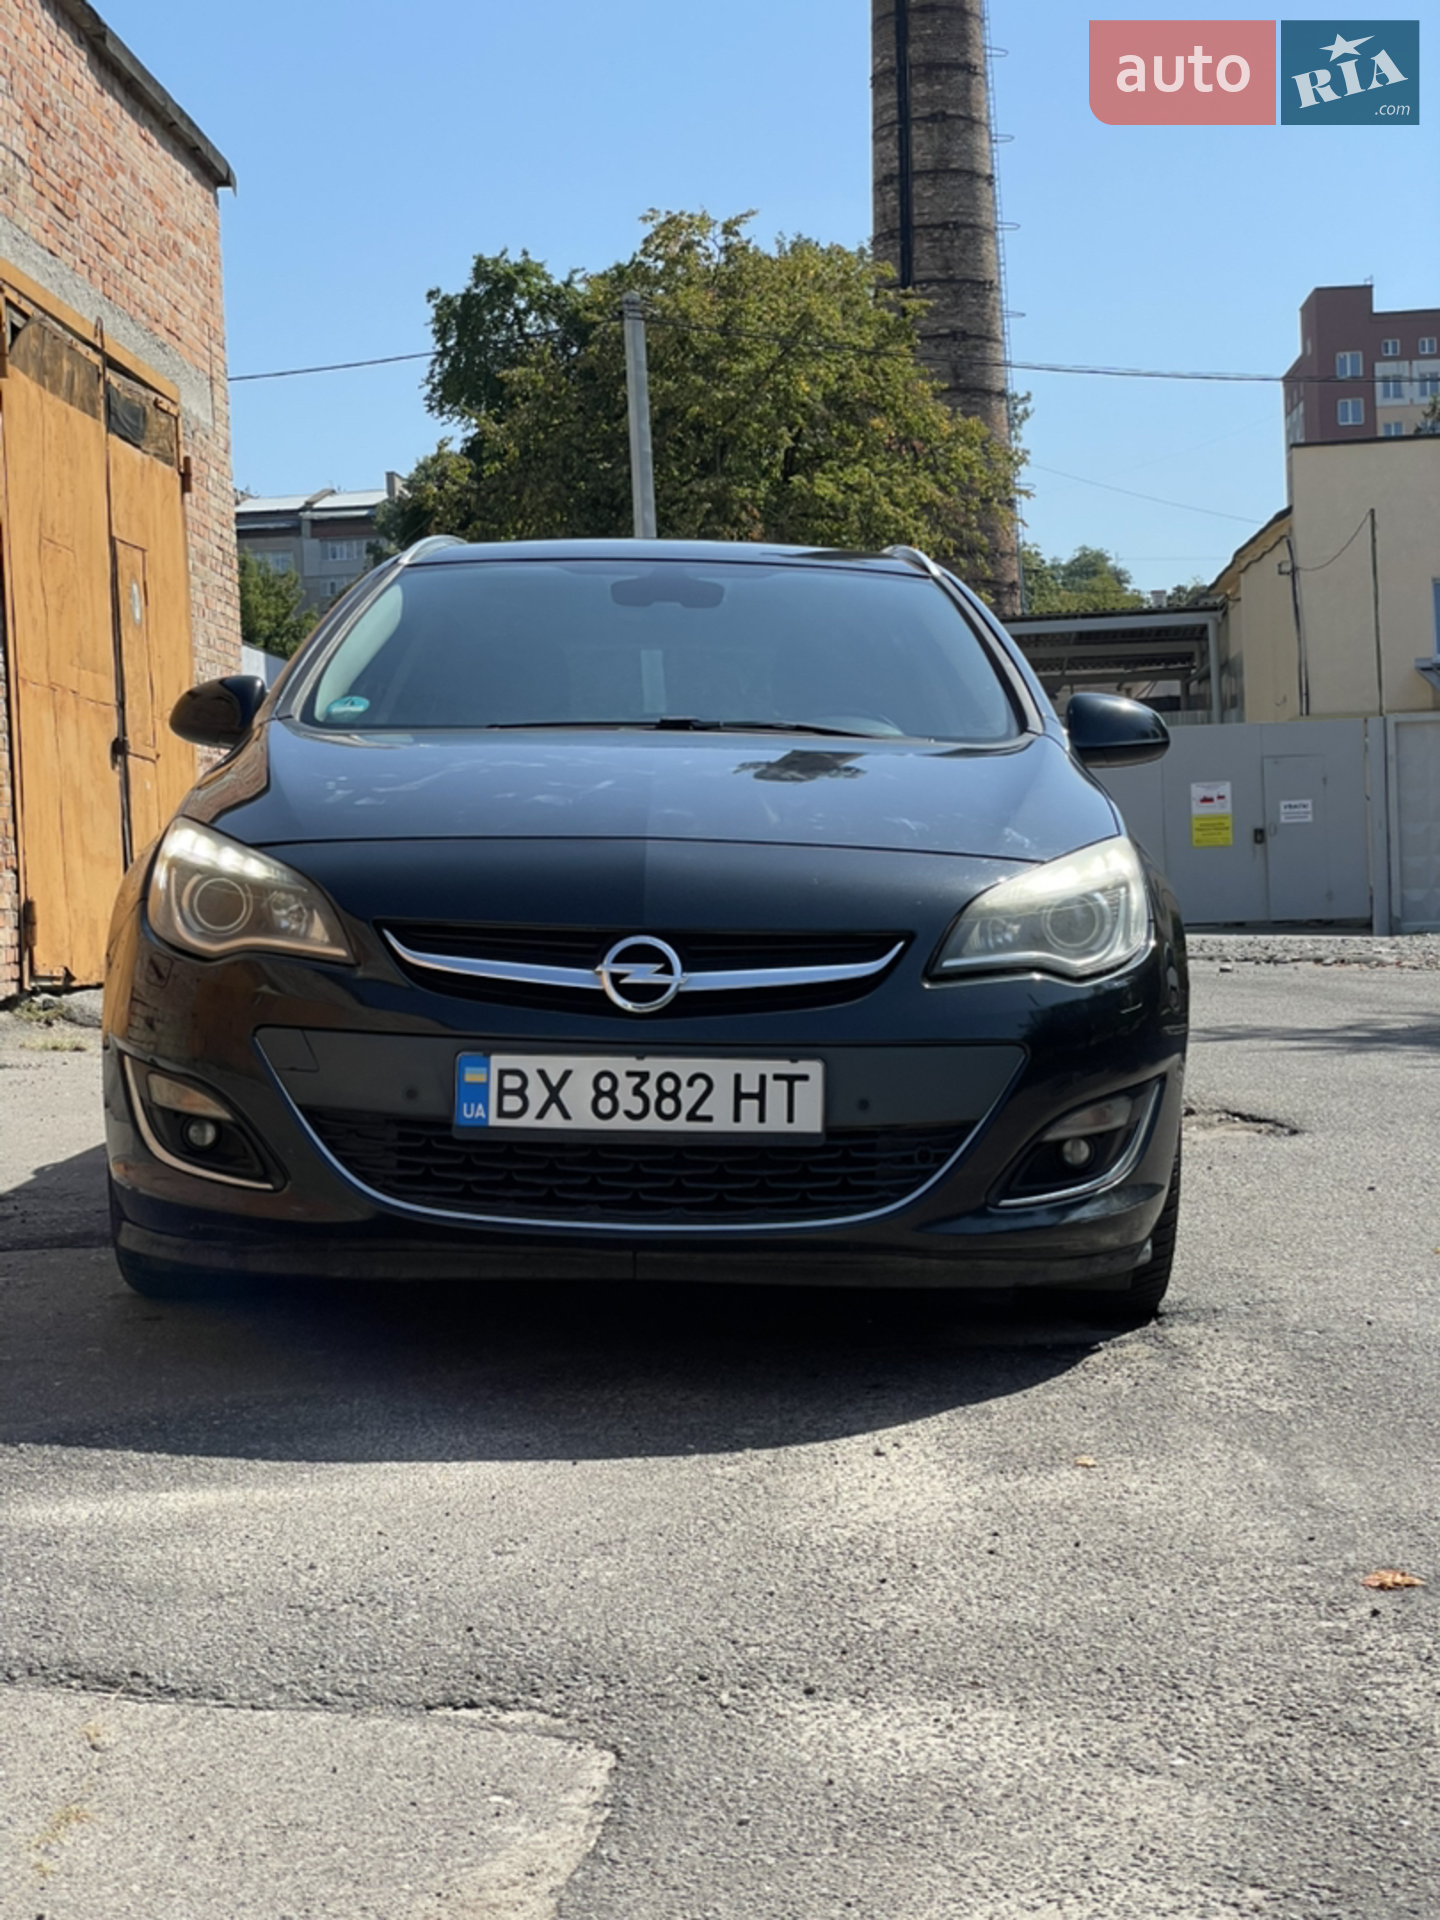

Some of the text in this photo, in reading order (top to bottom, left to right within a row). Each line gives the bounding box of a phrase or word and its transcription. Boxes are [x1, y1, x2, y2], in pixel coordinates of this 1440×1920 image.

[463, 1102, 486, 1119] UA
[496, 1068, 810, 1124] BX 8382 HT
